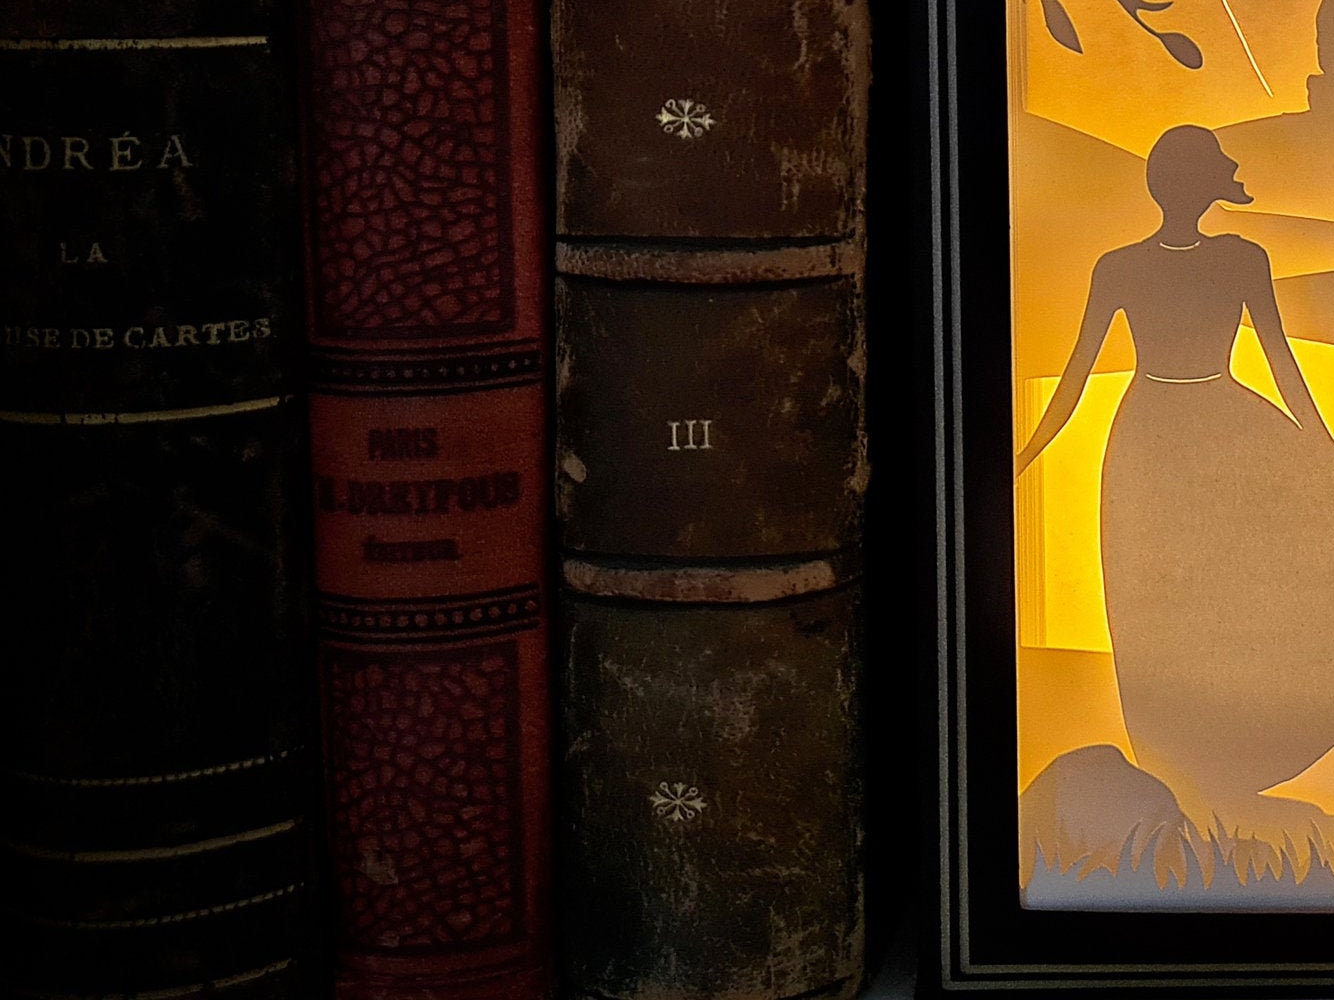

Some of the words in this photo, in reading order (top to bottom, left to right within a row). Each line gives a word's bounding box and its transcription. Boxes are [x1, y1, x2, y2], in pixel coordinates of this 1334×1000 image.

[59, 241, 109, 264] LA
[71, 328, 115, 349] DE
[122, 317, 271, 350] CARTES
[666, 420, 713, 451] III
